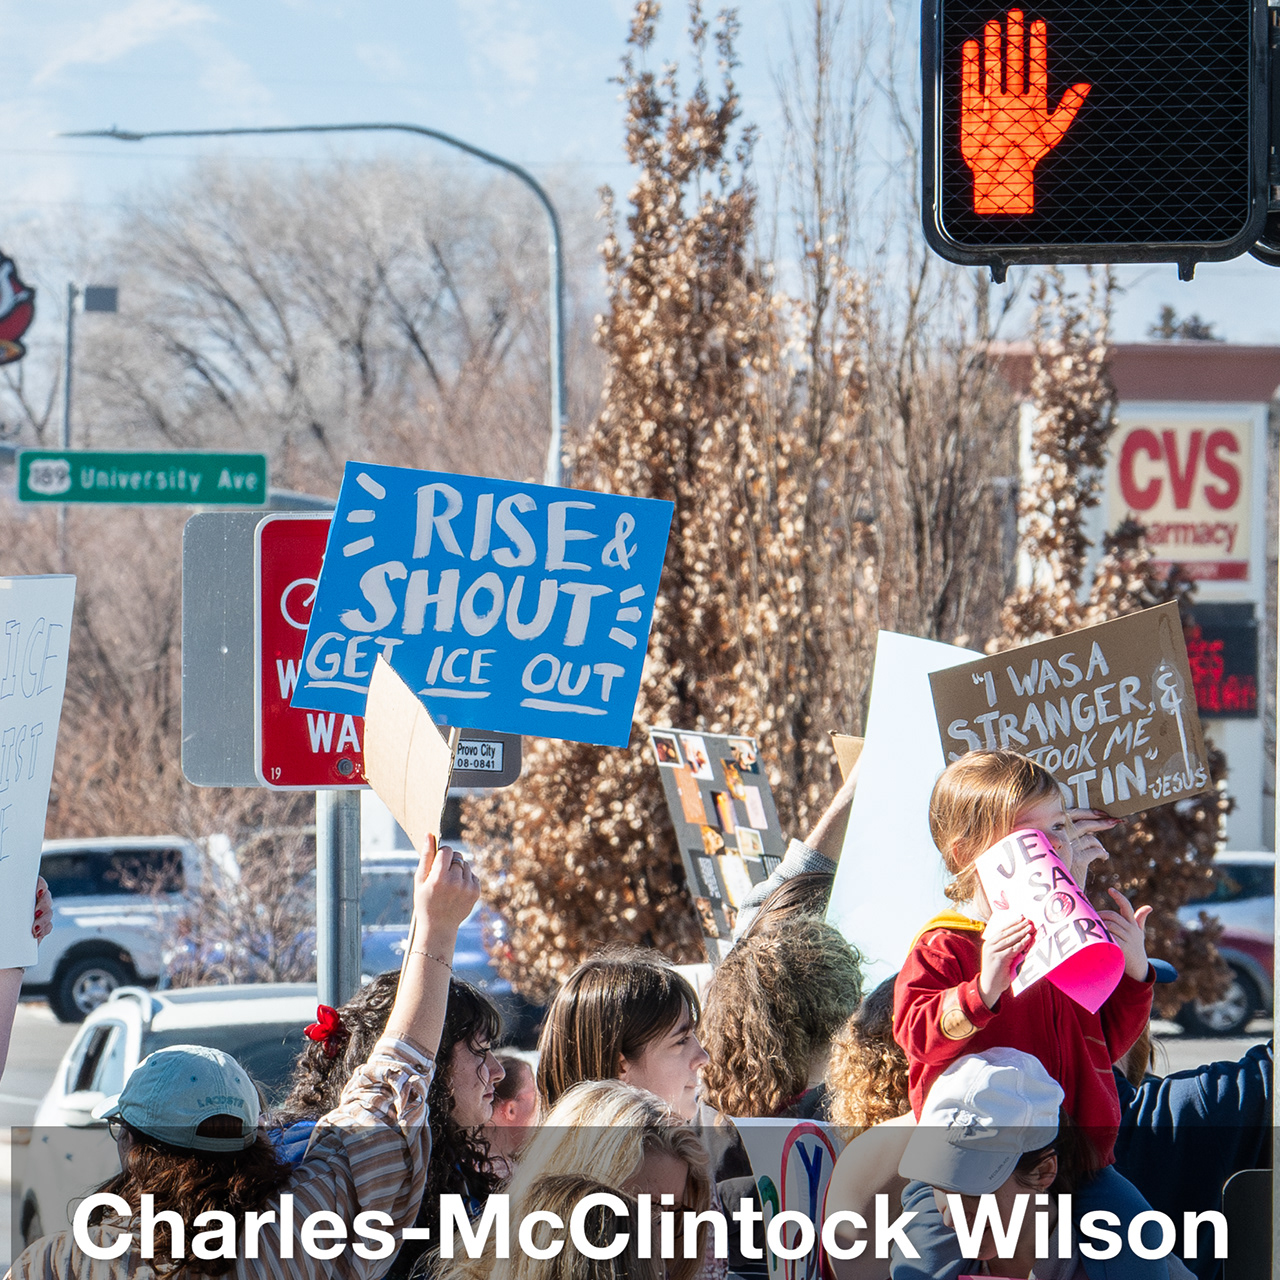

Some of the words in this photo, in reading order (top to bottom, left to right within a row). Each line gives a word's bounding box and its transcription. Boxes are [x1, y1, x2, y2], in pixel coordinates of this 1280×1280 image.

[80, 466, 203, 494] University
[216, 467, 259, 492] Ave
[1119, 428, 1241, 510] CVS
[412, 482, 598, 572] RISE
[601, 512, 638, 570] &
[339, 560, 614, 647] SHOUT
[1, 616, 64, 700] ICE
[305, 632, 404, 681] GET
[426, 645, 498, 686] ICE
[521, 652, 627, 702] OUT
[1006, 652, 1084, 697] WAS
[1085, 641, 1110, 681] A
[306, 713, 362, 753] WA
[457, 743, 478, 757] Provo
[481, 742, 496, 759] City
[1103, 717, 1154, 761] ME
[270, 767, 282, 781] 19
[457, 758, 495, 770] 08-0841
